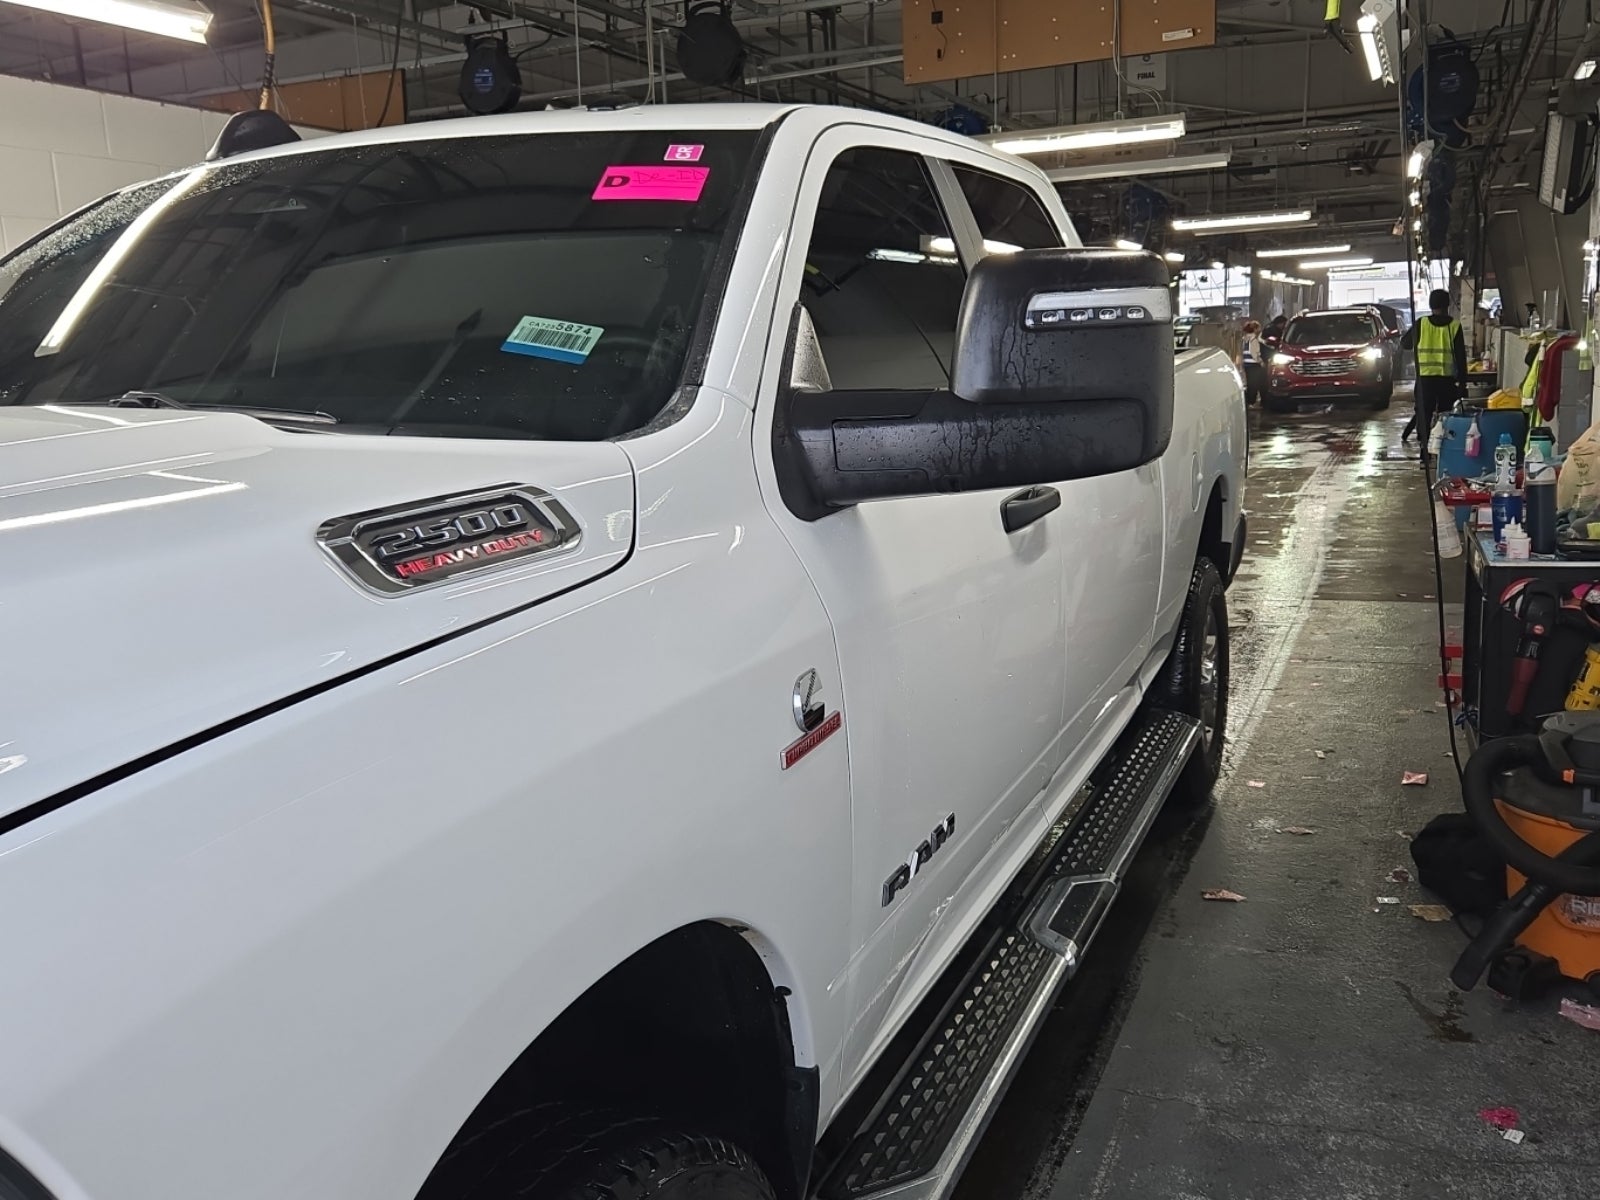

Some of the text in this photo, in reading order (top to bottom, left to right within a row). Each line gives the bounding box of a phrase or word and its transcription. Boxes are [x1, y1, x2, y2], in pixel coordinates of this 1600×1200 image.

[1137, 71, 1155, 80] FINAL
[675, 146, 694, 159] CR
[602, 175, 630, 188] D
[370, 503, 528, 559] 2500
[394, 528, 544, 578] HEAVY DUTY
[881, 811, 955, 908] RAM
